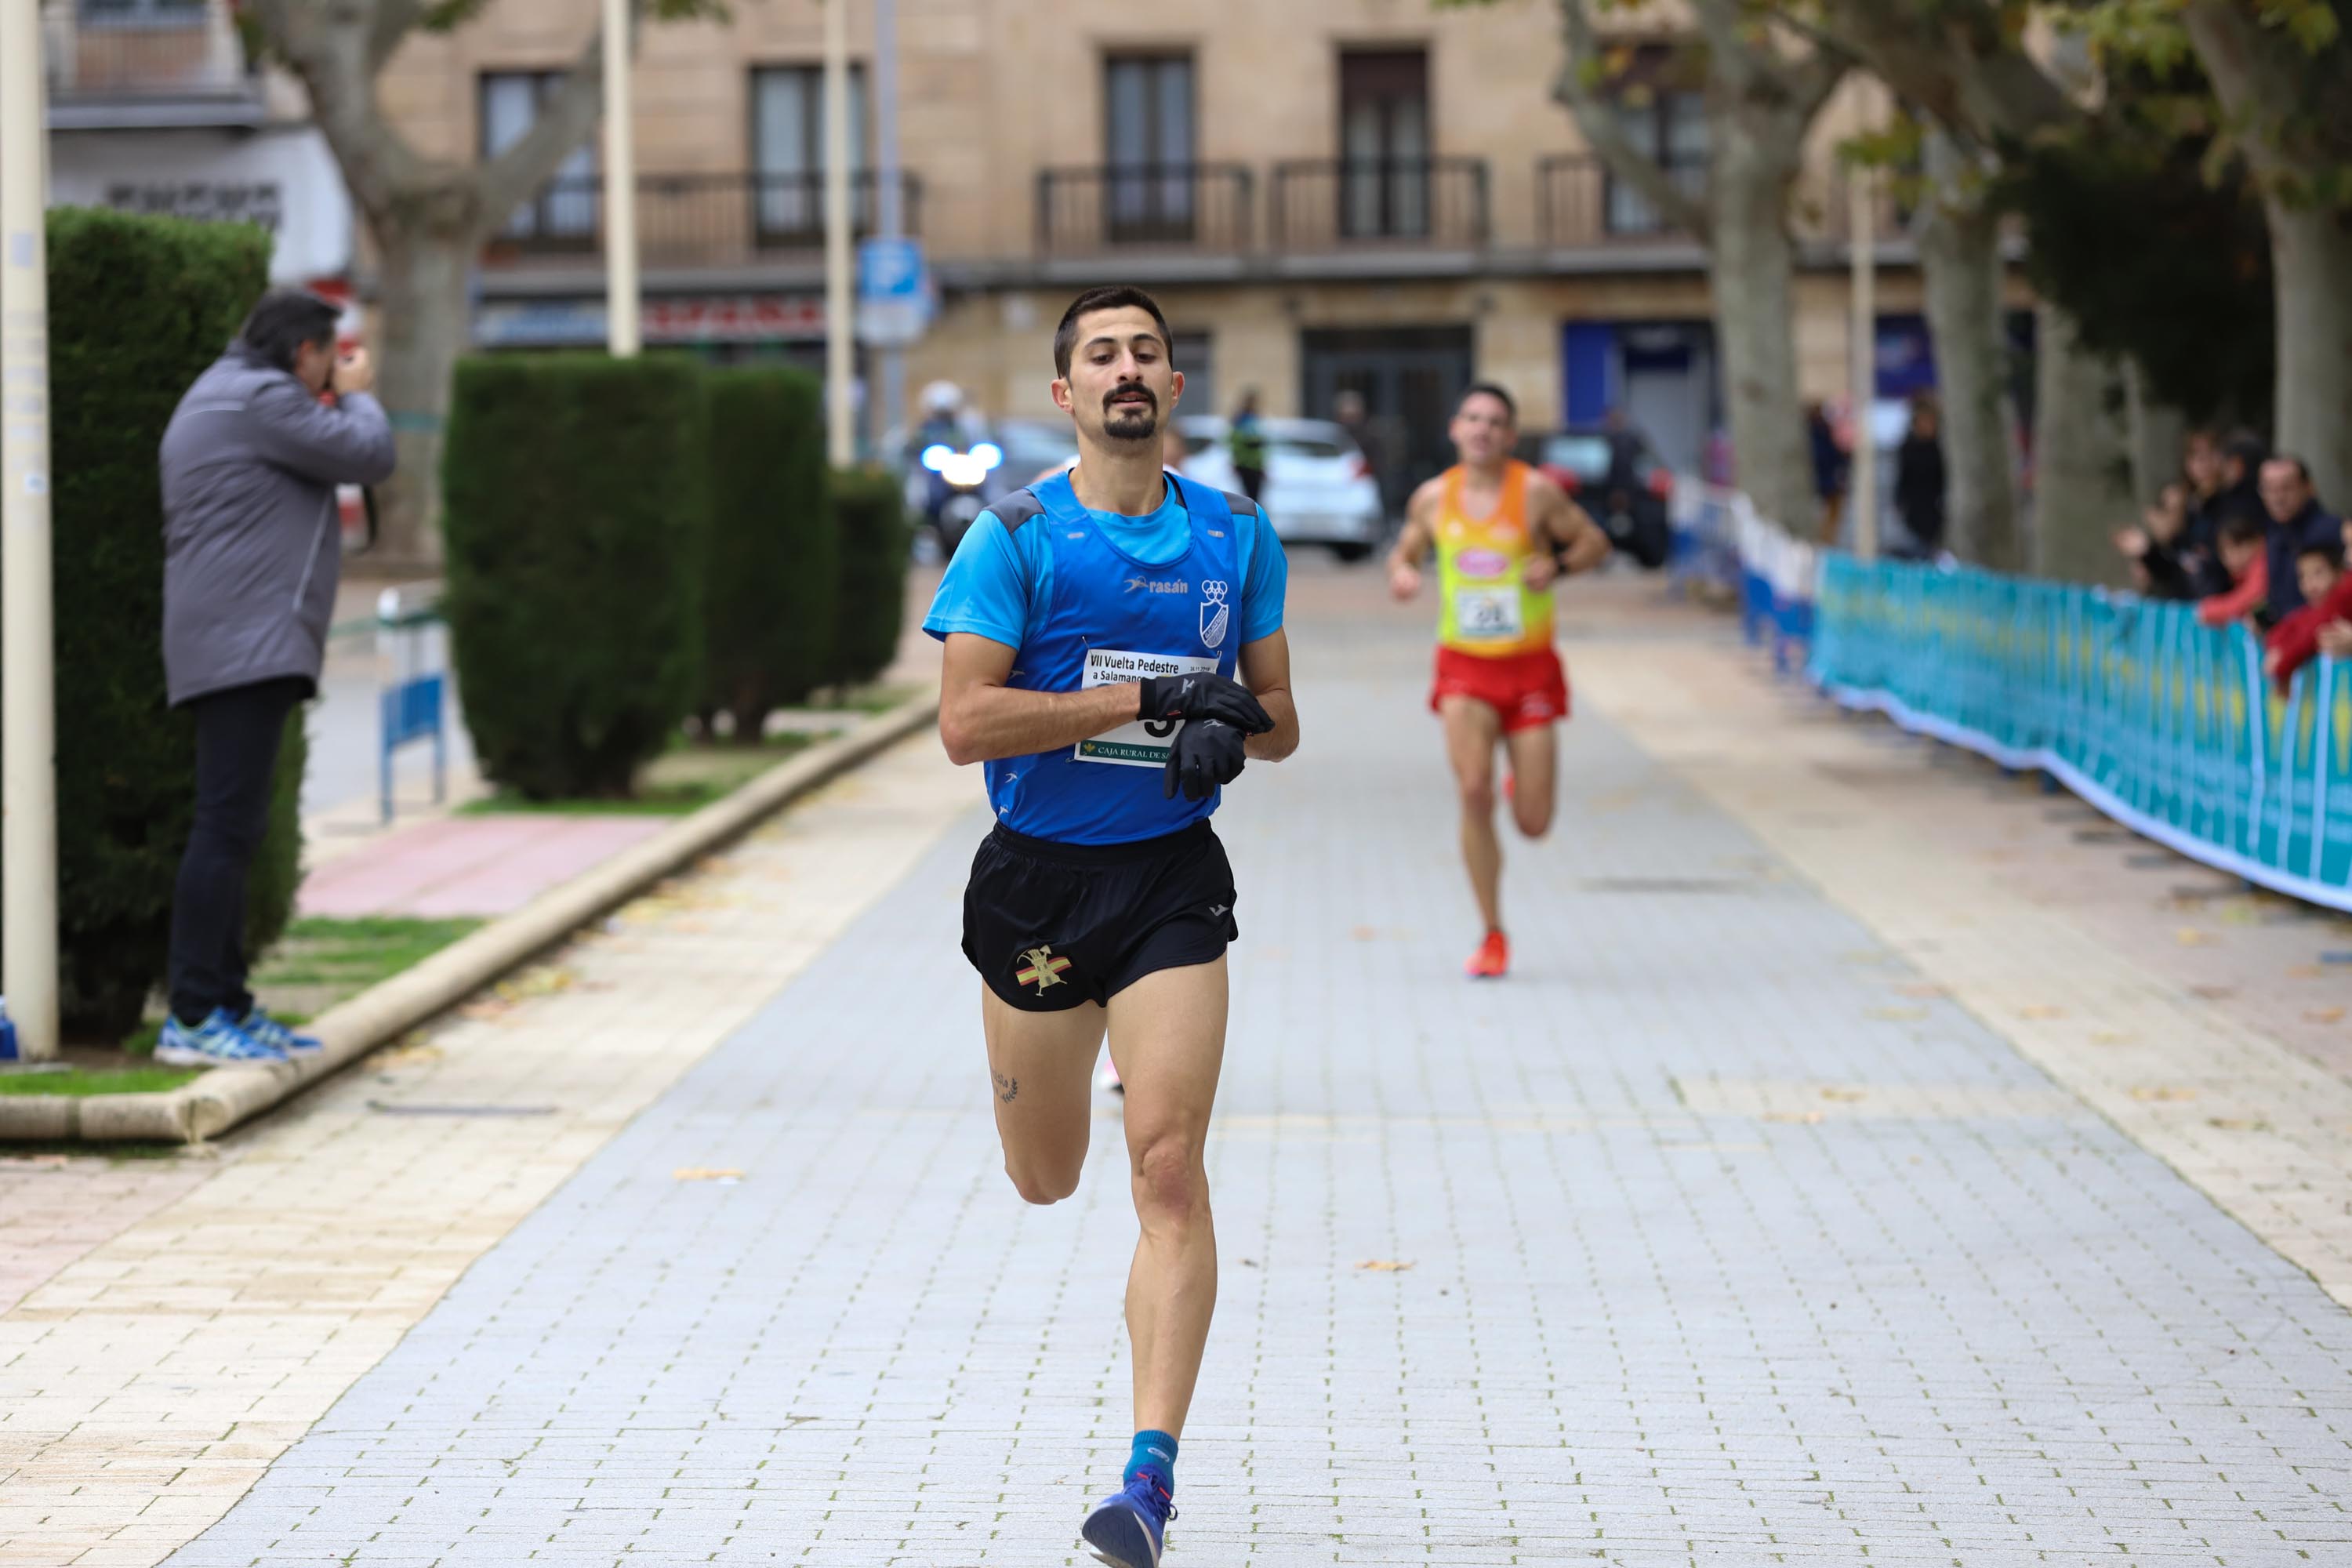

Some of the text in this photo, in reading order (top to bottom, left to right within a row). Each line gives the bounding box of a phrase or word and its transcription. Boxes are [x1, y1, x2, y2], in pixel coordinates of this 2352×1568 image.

[1149, 579, 1189, 593] rasán
[1091, 655, 1179, 674] VII Vuelta Pedestre
[1098, 746, 1118, 757] CAJA
[1120, 749, 1148, 758] RURAL
